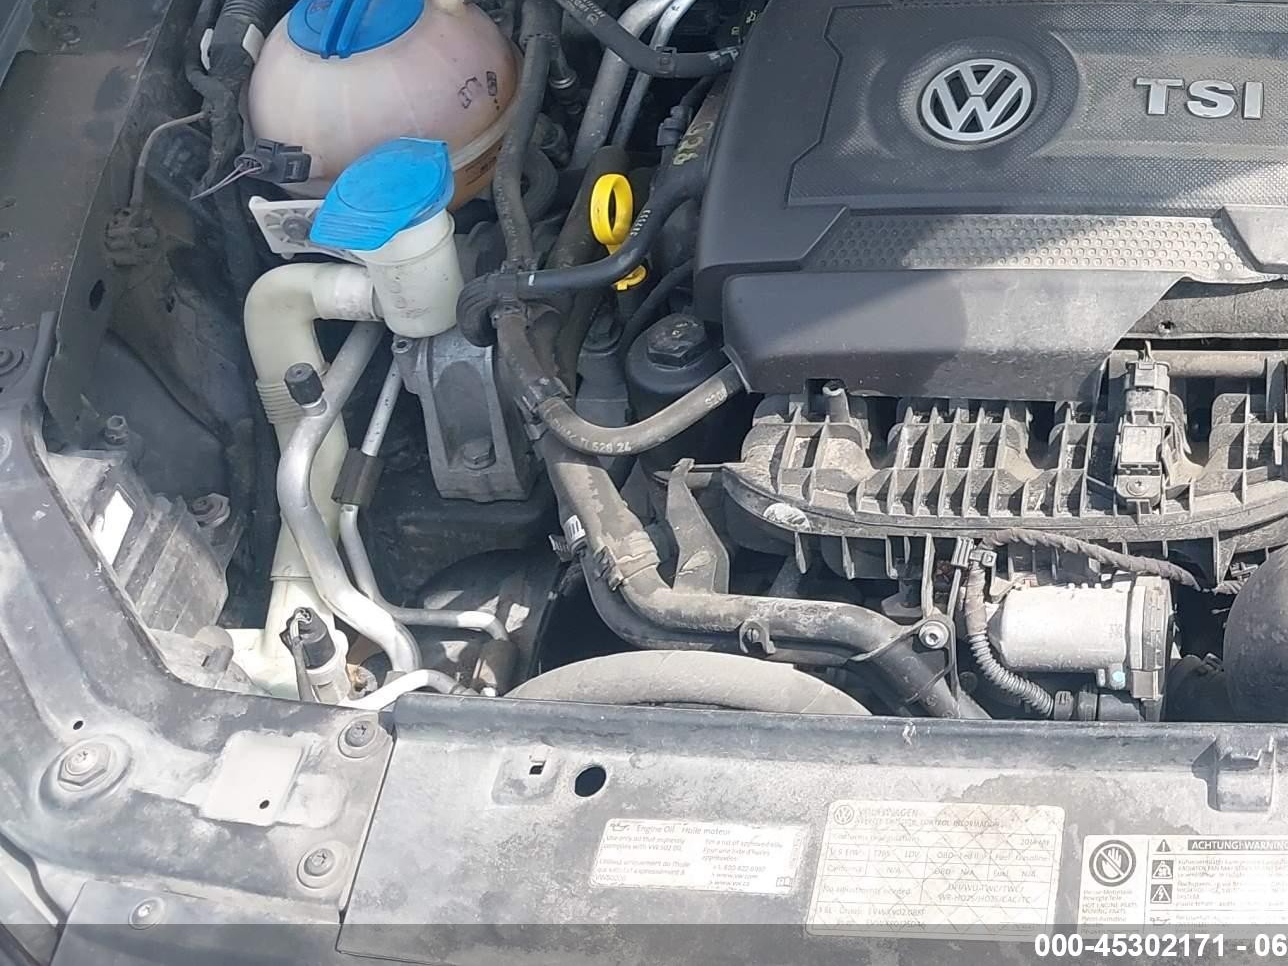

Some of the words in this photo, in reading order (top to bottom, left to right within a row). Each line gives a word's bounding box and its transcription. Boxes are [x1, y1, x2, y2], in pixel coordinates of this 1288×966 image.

[921, 58, 1031, 141] VW
[1135, 77, 1262, 119] TSI
[636, 824, 663, 835] Engine
[664, 825, 675, 834] Oil
[703, 827, 731, 835] moteur
[1191, 840, 1242, 850] ACHTUNG!
